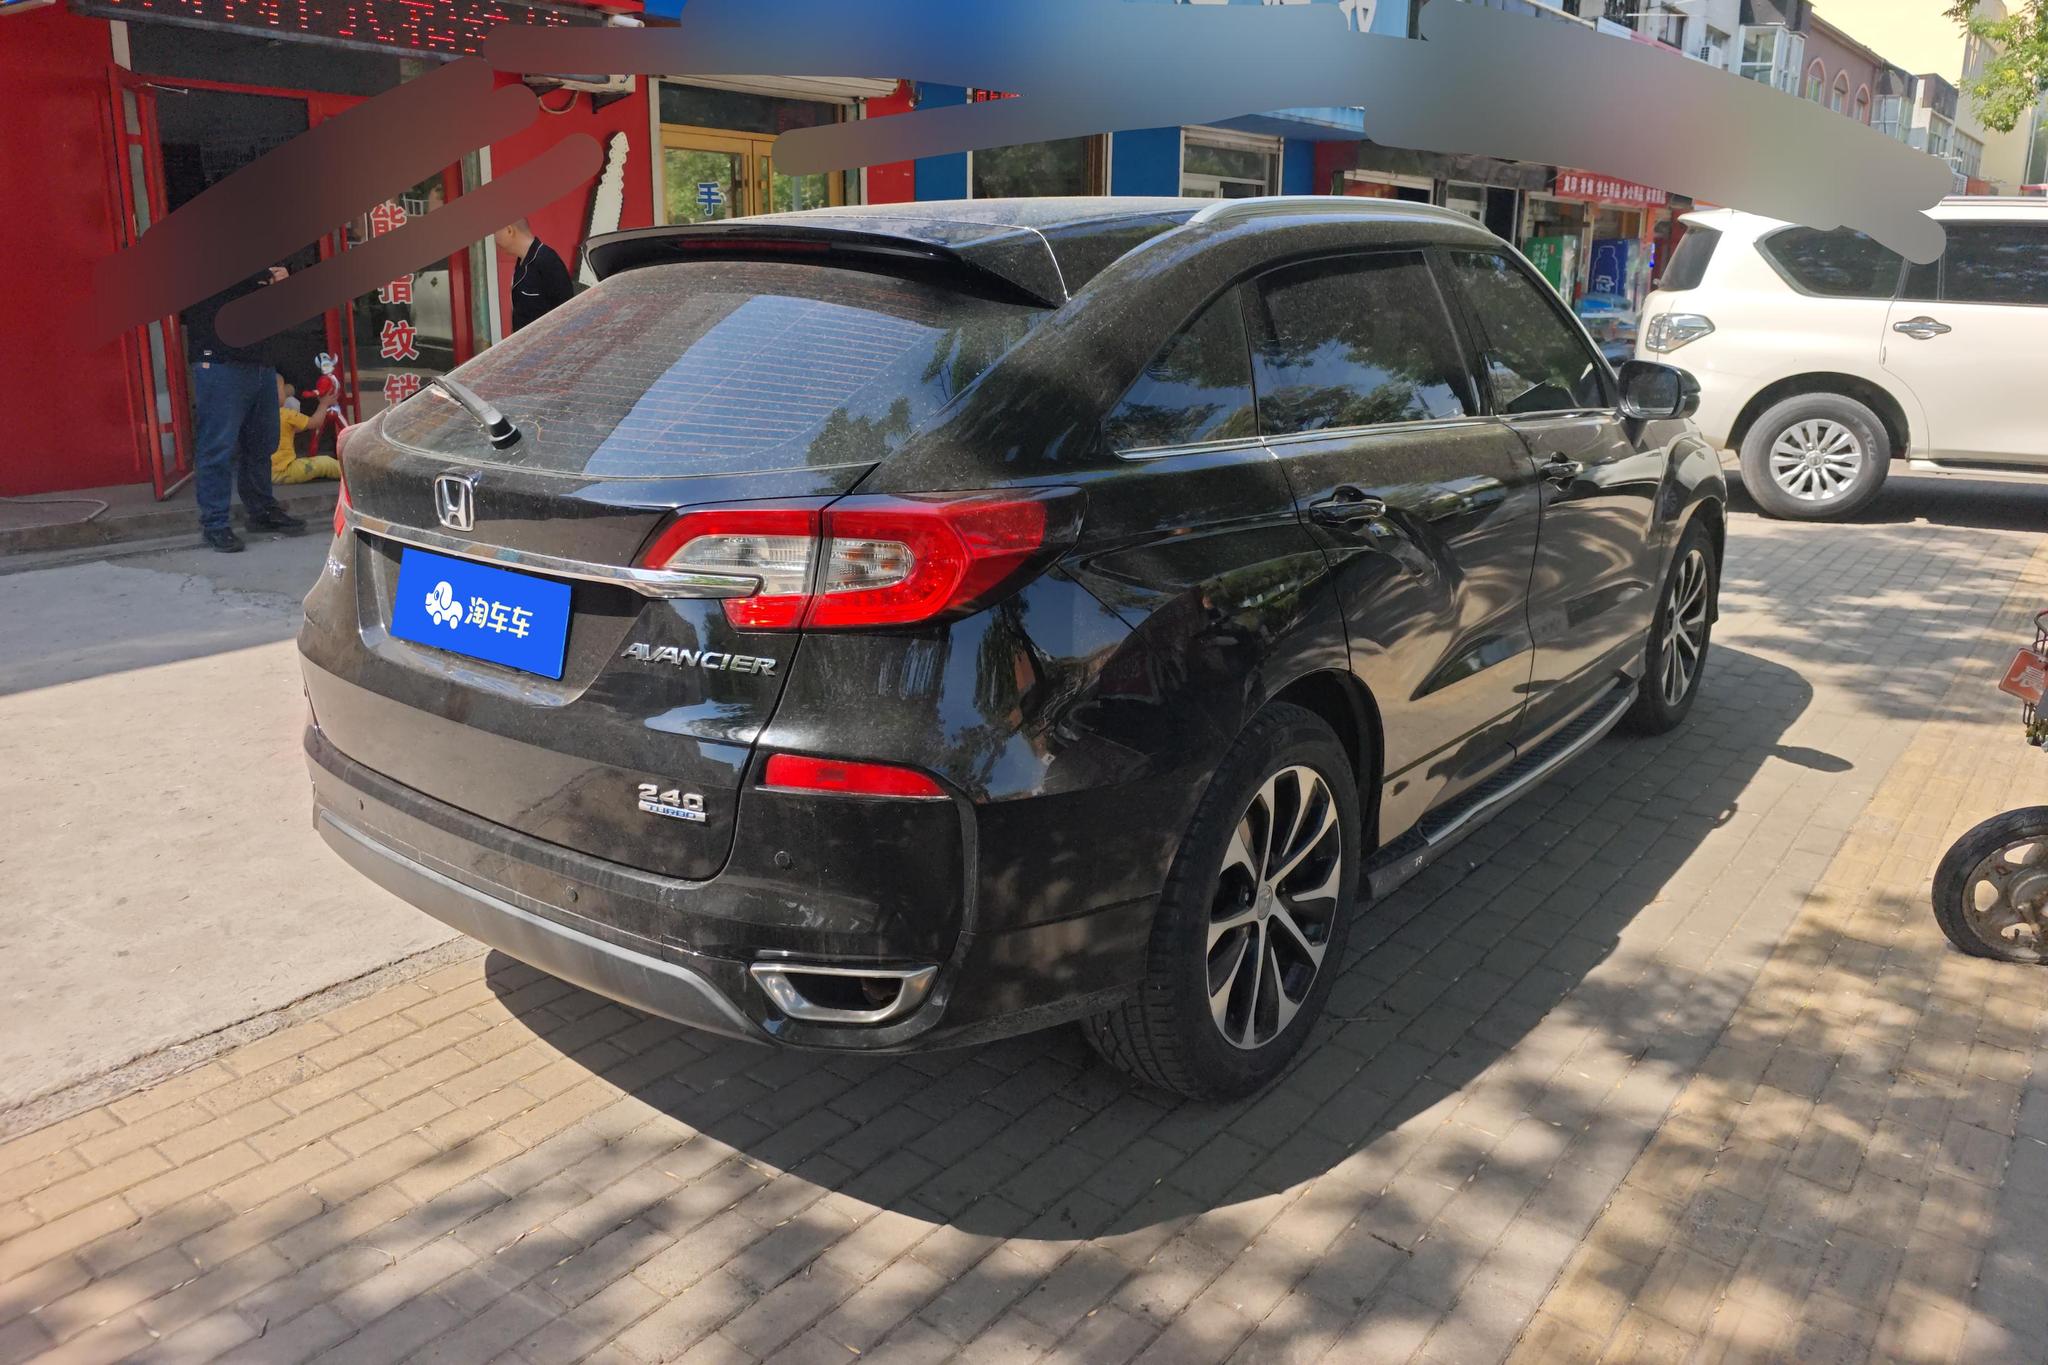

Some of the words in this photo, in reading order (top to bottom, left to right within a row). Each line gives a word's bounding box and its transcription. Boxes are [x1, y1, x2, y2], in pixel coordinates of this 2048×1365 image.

[621, 642, 777, 677] AVANCIER
[637, 783, 704, 812] 240
[647, 804, 698, 820] TURBO
